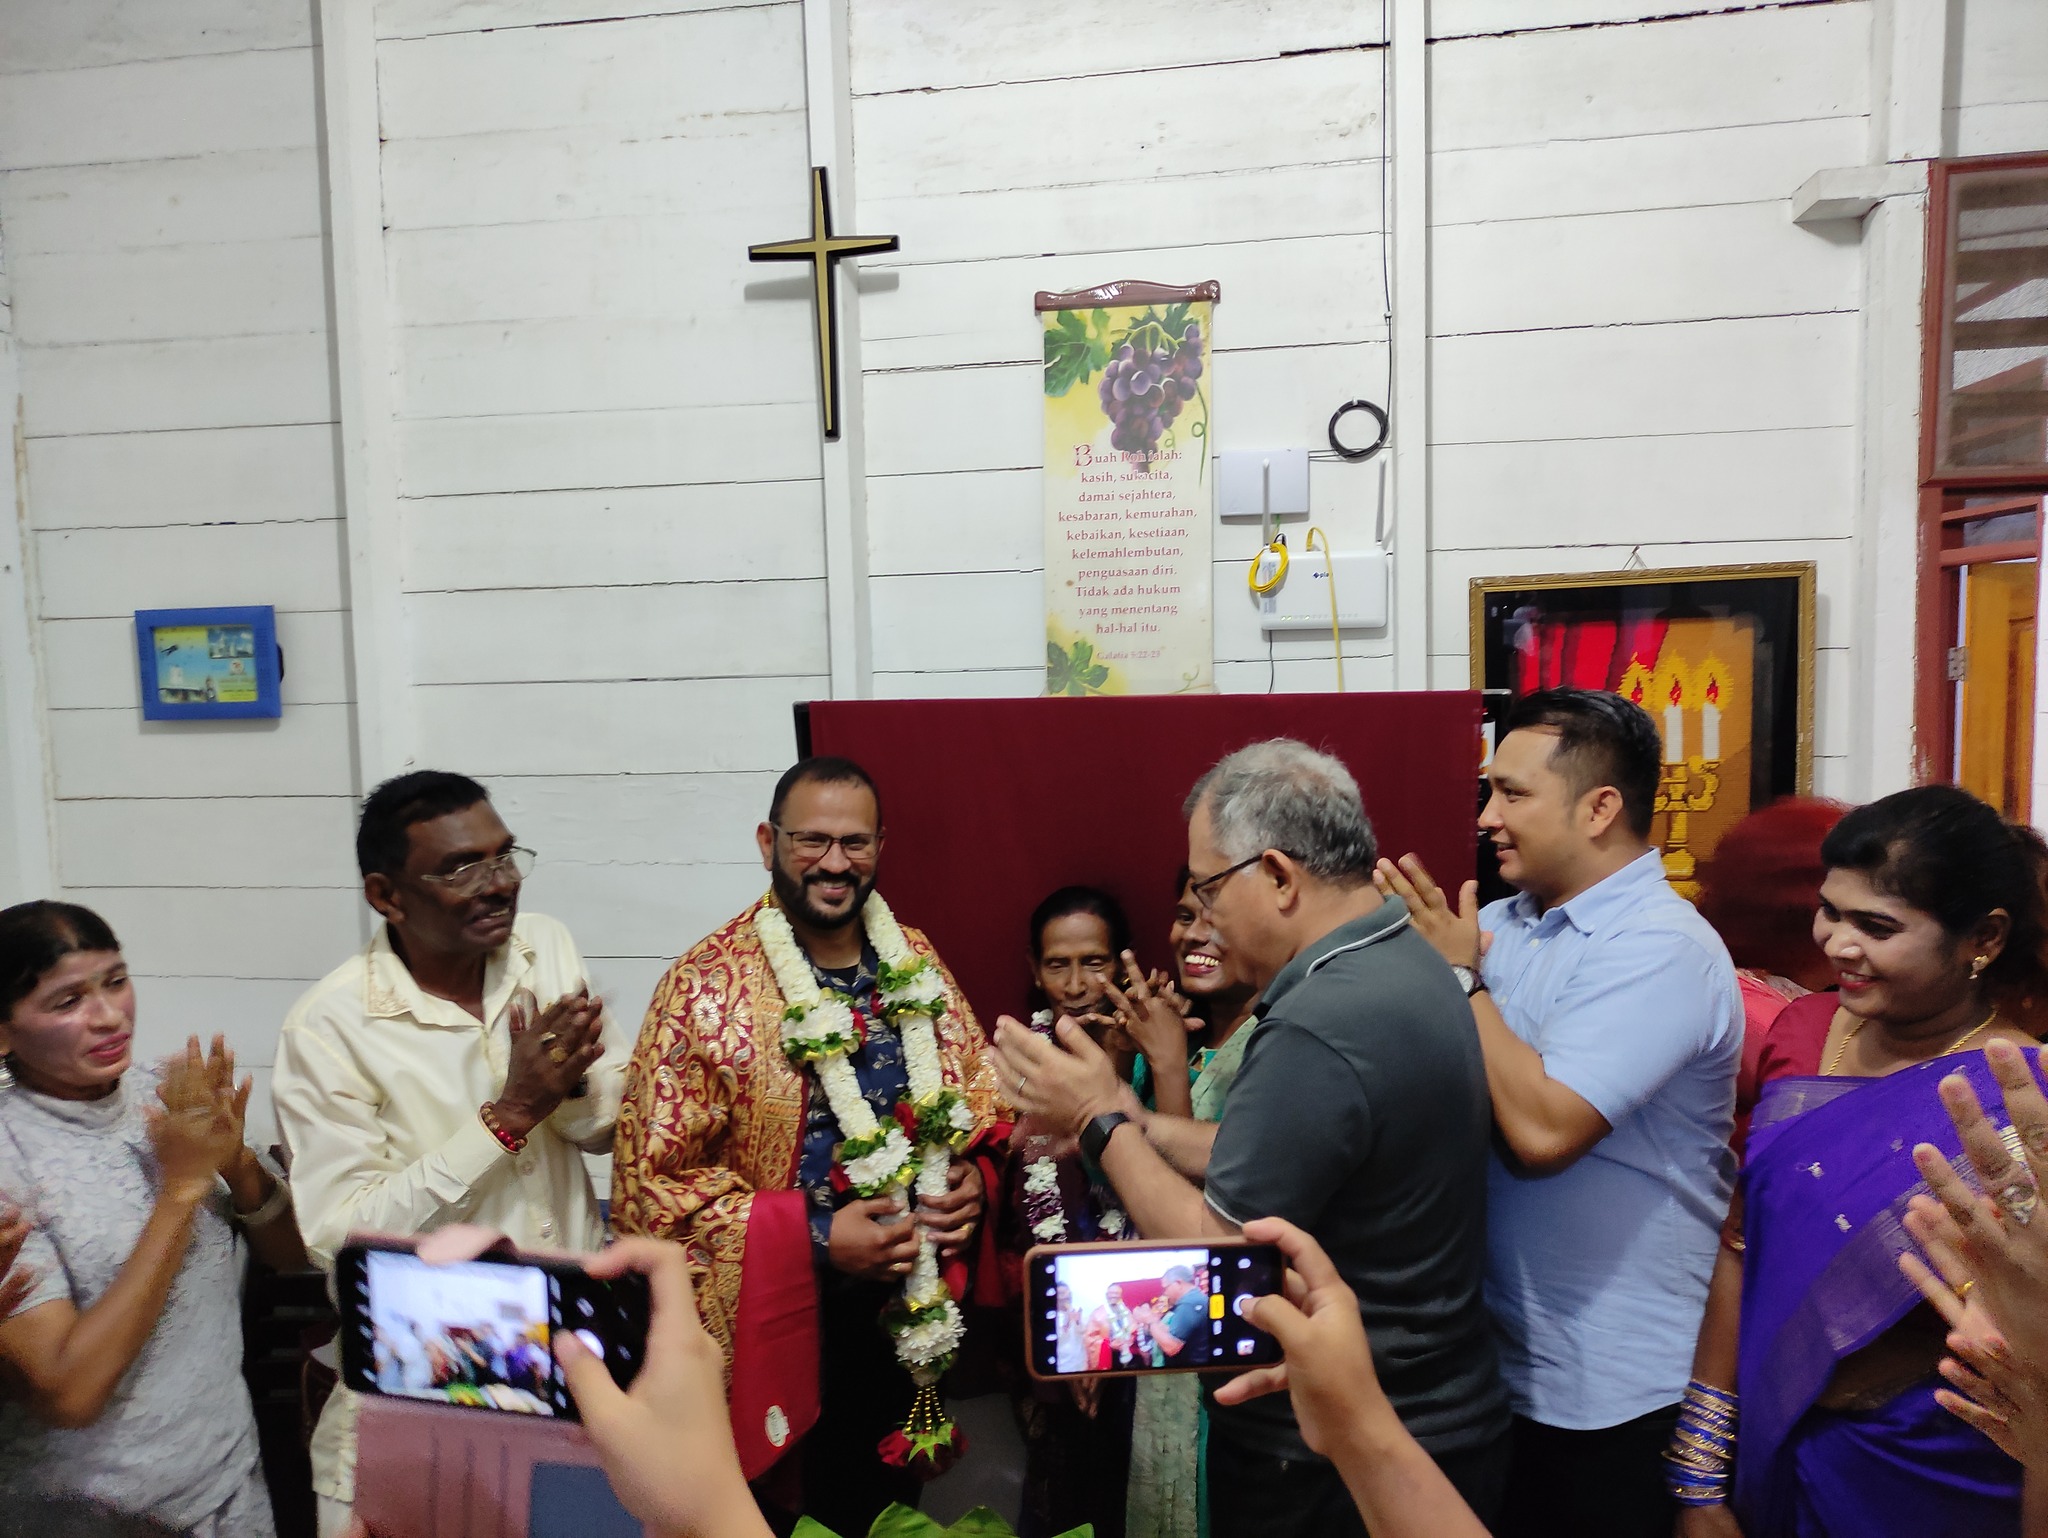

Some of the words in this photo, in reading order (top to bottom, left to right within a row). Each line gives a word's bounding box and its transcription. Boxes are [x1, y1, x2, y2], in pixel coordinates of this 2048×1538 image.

[1073, 444, 1117, 467] Buah
[1121, 450, 1146, 463] Roh
[1148, 449, 1182, 462] ialah:
[1081, 472, 1117, 483] kasih,
[1120, 470, 1173, 482] sukacita,
[1078, 490, 1115, 502] damai
[1119, 489, 1176, 503] sejahtera,
[1058, 511, 1122, 522] kesabaran,
[1125, 507, 1198, 520] kemurahan,
[1066, 529, 1126, 541] kebaikan,
[1129, 526, 1189, 539] kesetiaan,
[1072, 547, 1184, 560] kelemahlembutan,
[1078, 568, 1148, 580] penguasaan
[1151, 564, 1177, 576] diri.
[1075, 585, 1109, 597] Tidak
[1113, 584, 1134, 596] ada
[1137, 583, 1181, 595] hukum
[1079, 606, 1108, 619] yang
[1111, 604, 1178, 616] menentang
[1096, 622, 1137, 634] hal-hal
[1140, 622, 1161, 633] itu.
